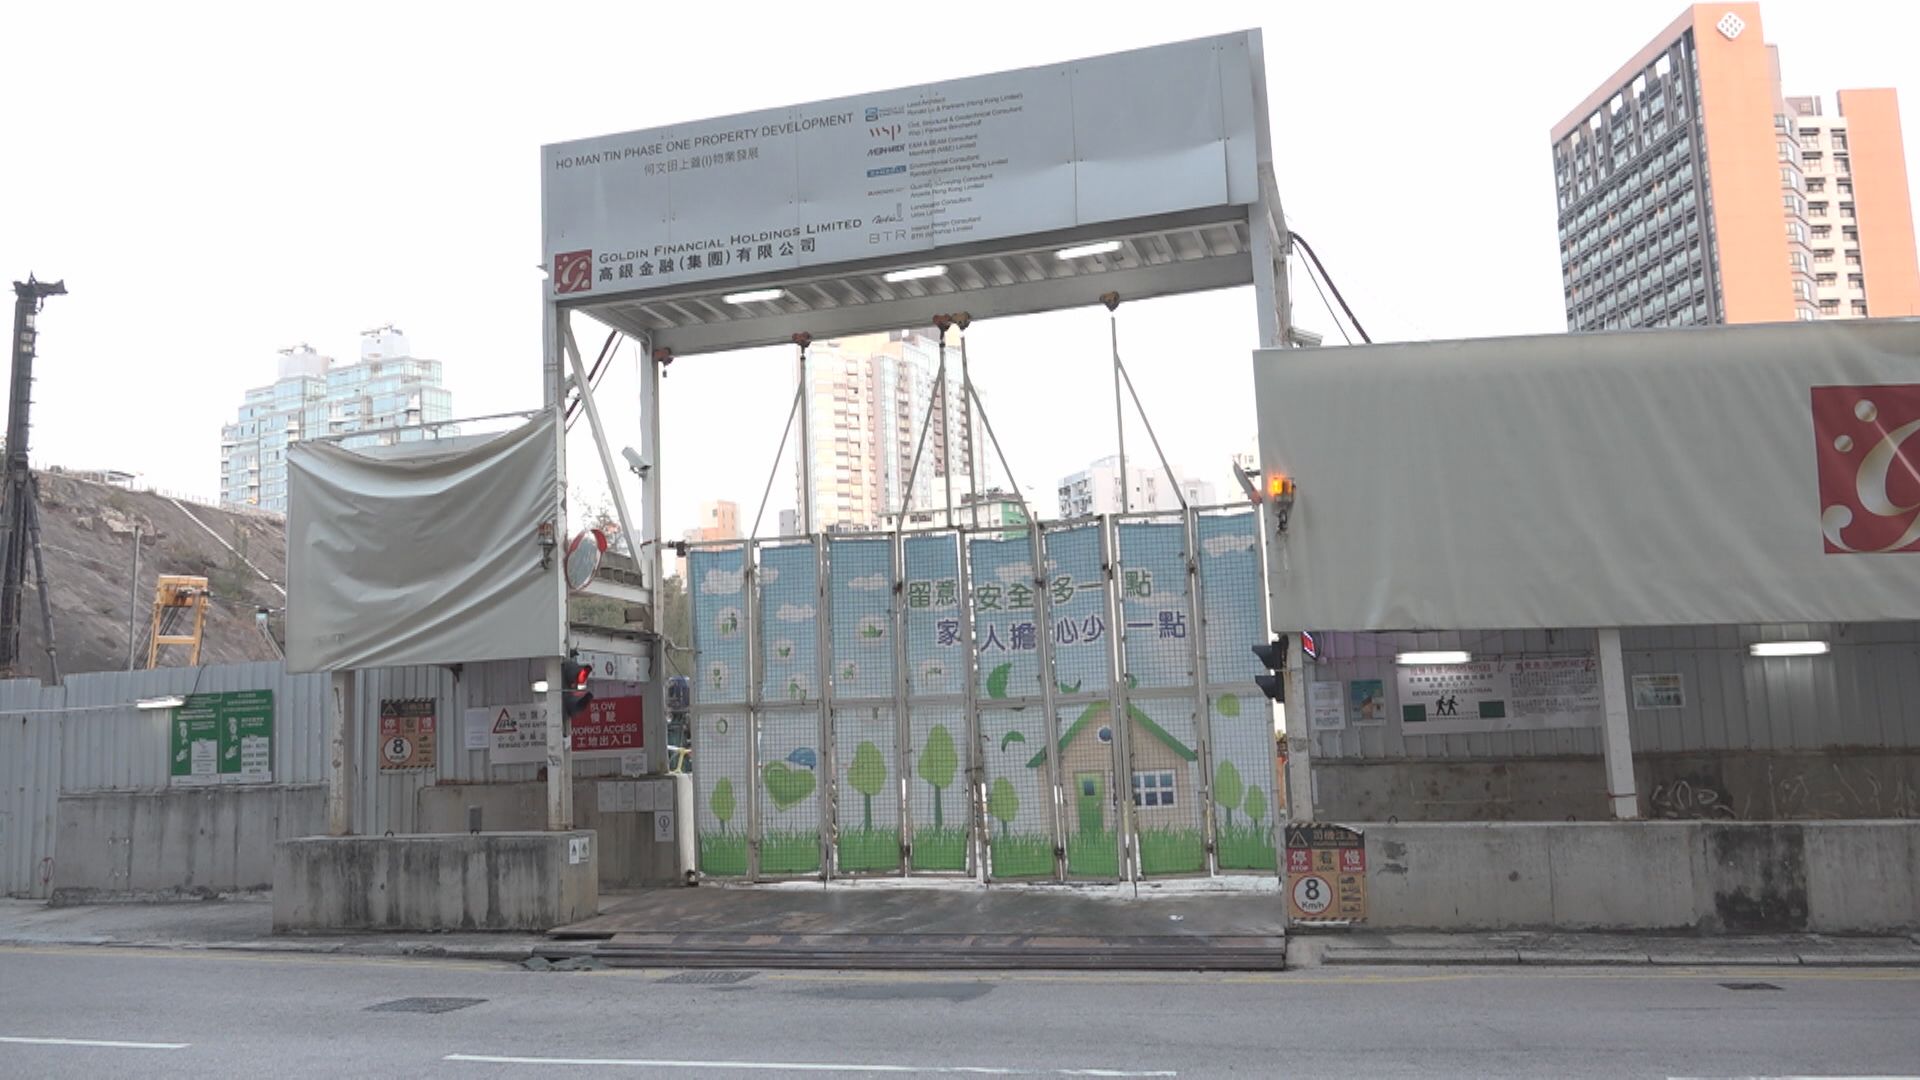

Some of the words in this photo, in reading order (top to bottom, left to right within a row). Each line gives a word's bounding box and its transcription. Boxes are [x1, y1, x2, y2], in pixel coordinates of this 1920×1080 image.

[556, 157, 573, 170] HO
[575, 153, 600, 167] MAN
[603, 149, 621, 162] TIN
[624, 143, 662, 159] PHASE
[666, 139, 691, 152] ONE
[694, 128, 759, 148] PROPERTY
[762, 112, 854, 137] DEVELOPMENT
[599, 249, 649, 265] GOLDIN
[654, 239, 725, 256] FINANCIAL
[731, 227, 800, 245] HOLDINGS
[807, 219, 863, 234] LIMITED
[869, 228, 906, 244] BTR
[599, 237, 815, 282] 高銀金融(集團)有限公司
[571, 724, 601, 736] WORKS
[603, 722, 638, 734] ACCESS
[393, 738, 405, 755] 8
[576, 732, 632, 749] 工地出入口
[1304, 878, 1320, 901] 8
[1301, 900, 1325, 910] Km/h
